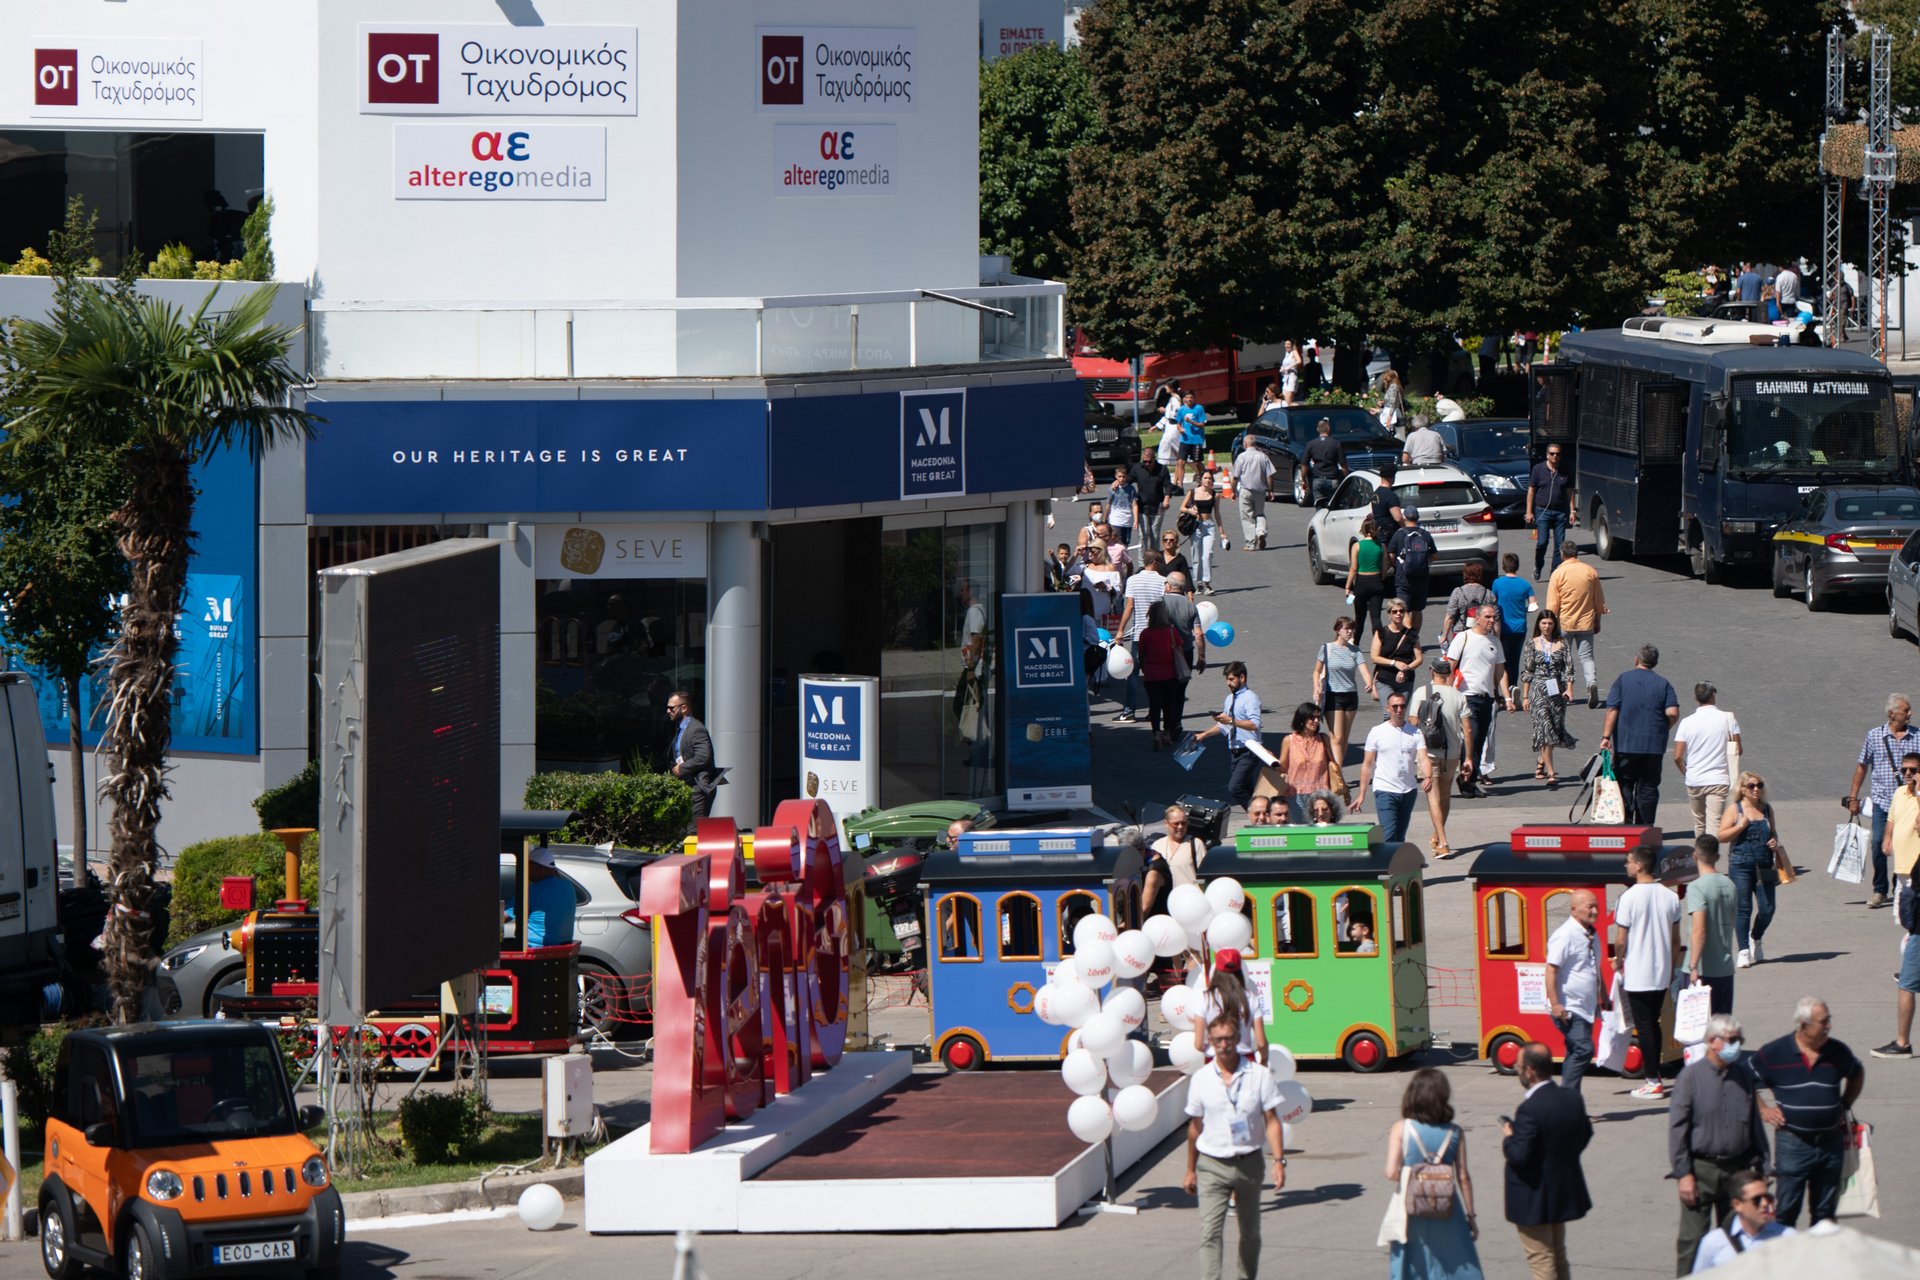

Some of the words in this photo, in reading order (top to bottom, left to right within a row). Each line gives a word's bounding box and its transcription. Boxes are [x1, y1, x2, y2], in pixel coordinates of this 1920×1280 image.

[1000, 28, 1045, 40] ΕΙΜΑΣΤΕ
[461, 41, 627, 71] Οικονομικός
[815, 43, 911, 72] Οικονομικός
[91, 55, 195, 80] Οικονομικός
[91, 80, 195, 105] Ταχυδρόμος
[461, 72, 627, 103] Ταχυδρόμος
[815, 73, 911, 103] Ταχυδρόμος
[408, 164, 592, 192] alteregomedia
[783, 163, 890, 190] alteregomedia
[1756, 381, 1808, 394] ΕΛΛΗΝΙΚΗ
[1813, 382, 1869, 394] ΑΣΤΥΝΟΜΙΑ
[392, 450, 439, 464] OUR
[453, 450, 567, 463] HERITAGE
[581, 450, 601, 463] IS
[615, 449, 688, 462] GREAT
[911, 456, 956, 468] MACEDONIA
[911, 472, 927, 482] THE
[929, 470, 956, 481] GREAT
[616, 539, 683, 559] SEVE
[807, 731, 851, 741] MACEDONIA
[1044, 728, 1068, 736] ΣΕΒΕ
[808, 742, 819, 750] THE
[820, 743, 851, 752] GREAT
[823, 780, 858, 792] SEVE
[223, 1242, 290, 1261] ECO-CAR
